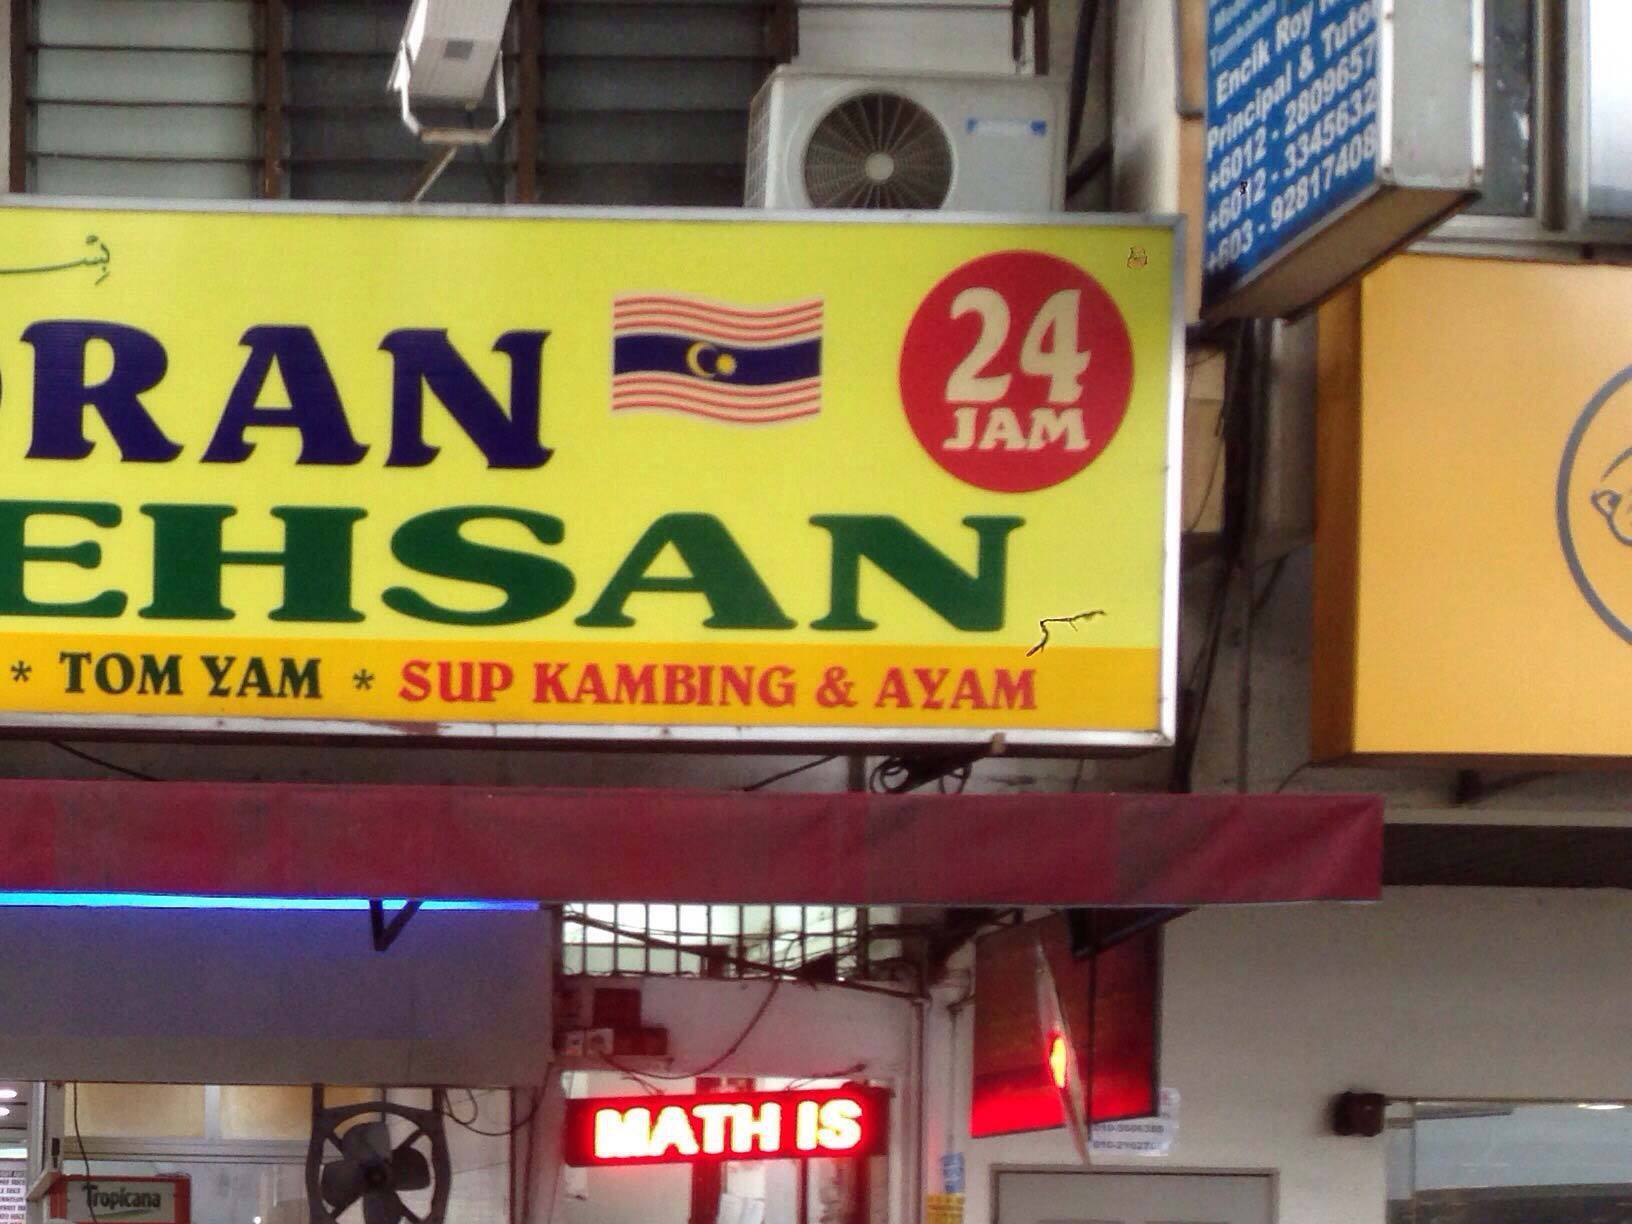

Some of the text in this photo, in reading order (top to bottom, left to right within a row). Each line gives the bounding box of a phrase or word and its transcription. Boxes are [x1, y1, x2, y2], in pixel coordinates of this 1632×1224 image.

[1217, 41, 1270, 107] Encik
[1275, 1, 1314, 51] Roy
[1207, 60, 1292, 161] Principal
[1299, 44, 1315, 80] &
[1209, 126, 1266, 193] +6012
[1285, 38, 1376, 136] 2809657
[1285, 78, 1376, 174] 3345632
[945, 287, 1092, 404] 24
[943, 405, 1090, 451] JAM
[58, 650, 323, 700] TOM YAM
[398, 659, 1039, 712] SUP KAMBING & AYAM
[594, 1098, 862, 1159] MATH IS
[82, 1184, 161, 1210] Tropicana
